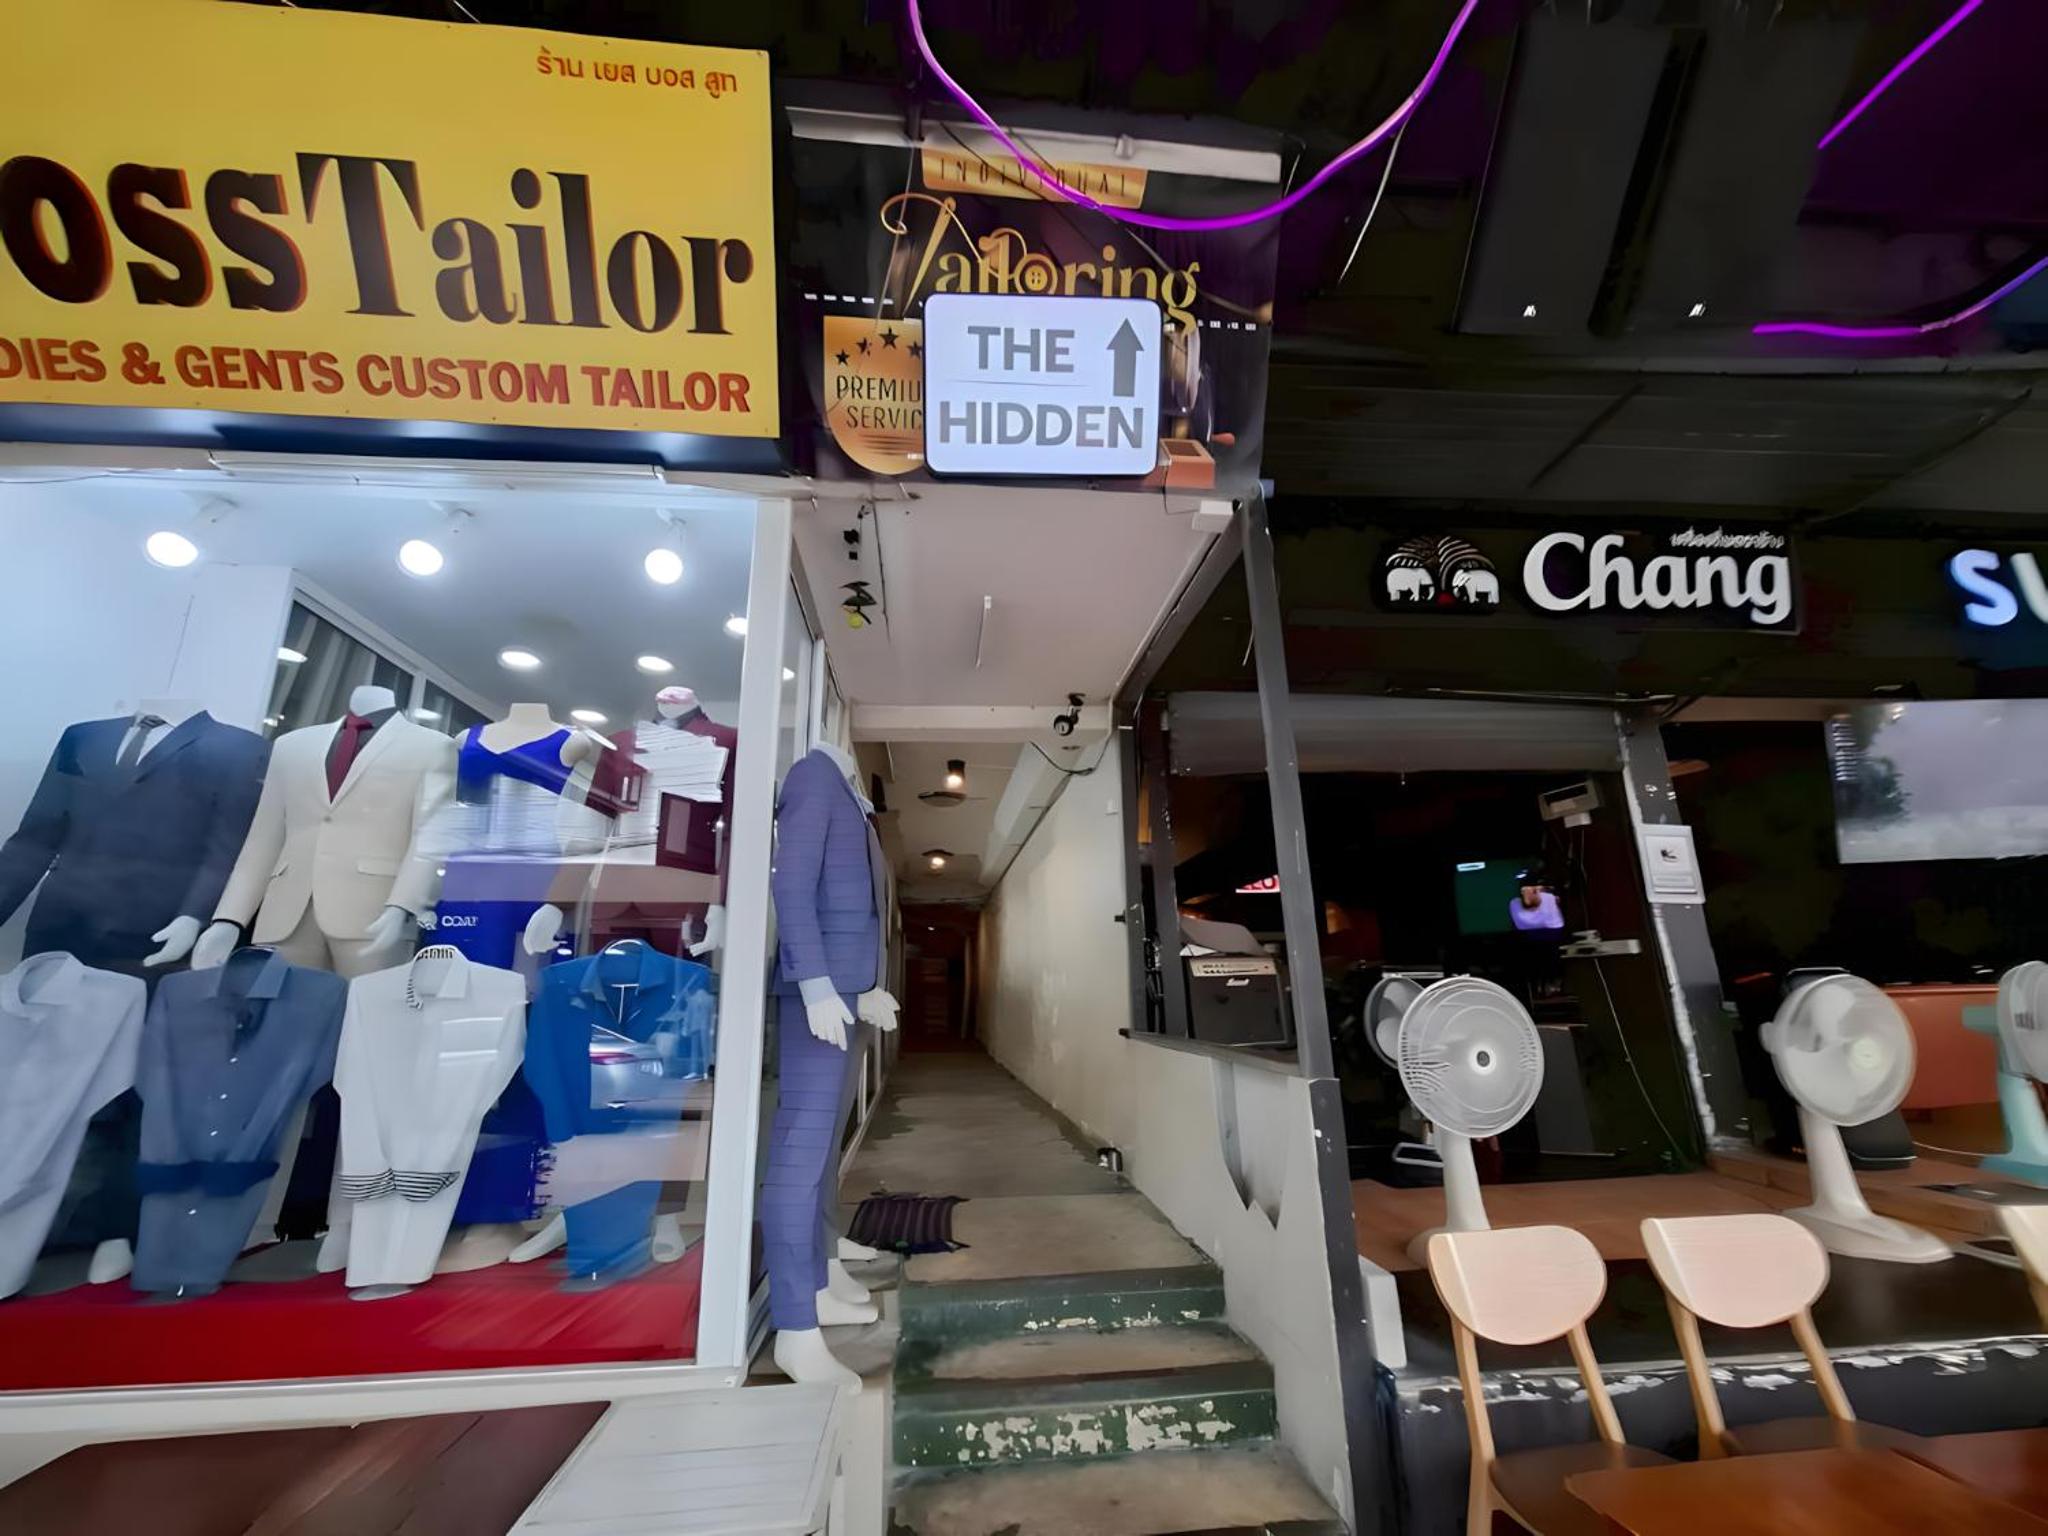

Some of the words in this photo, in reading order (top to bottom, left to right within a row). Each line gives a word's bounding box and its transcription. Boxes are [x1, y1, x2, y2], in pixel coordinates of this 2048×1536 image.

[537, 46, 584, 78] ร้าน
[646, 67, 695, 89] บอส
[967, 325, 1075, 373] THE
[121, 342, 166, 385] &
[175, 345, 344, 395] GENTS
[357, 353, 570, 404] CUSTOM
[581, 366, 750, 414] TAILOR
[939, 401, 1144, 449] HIDDEN
[1523, 532, 1791, 624] Chang
